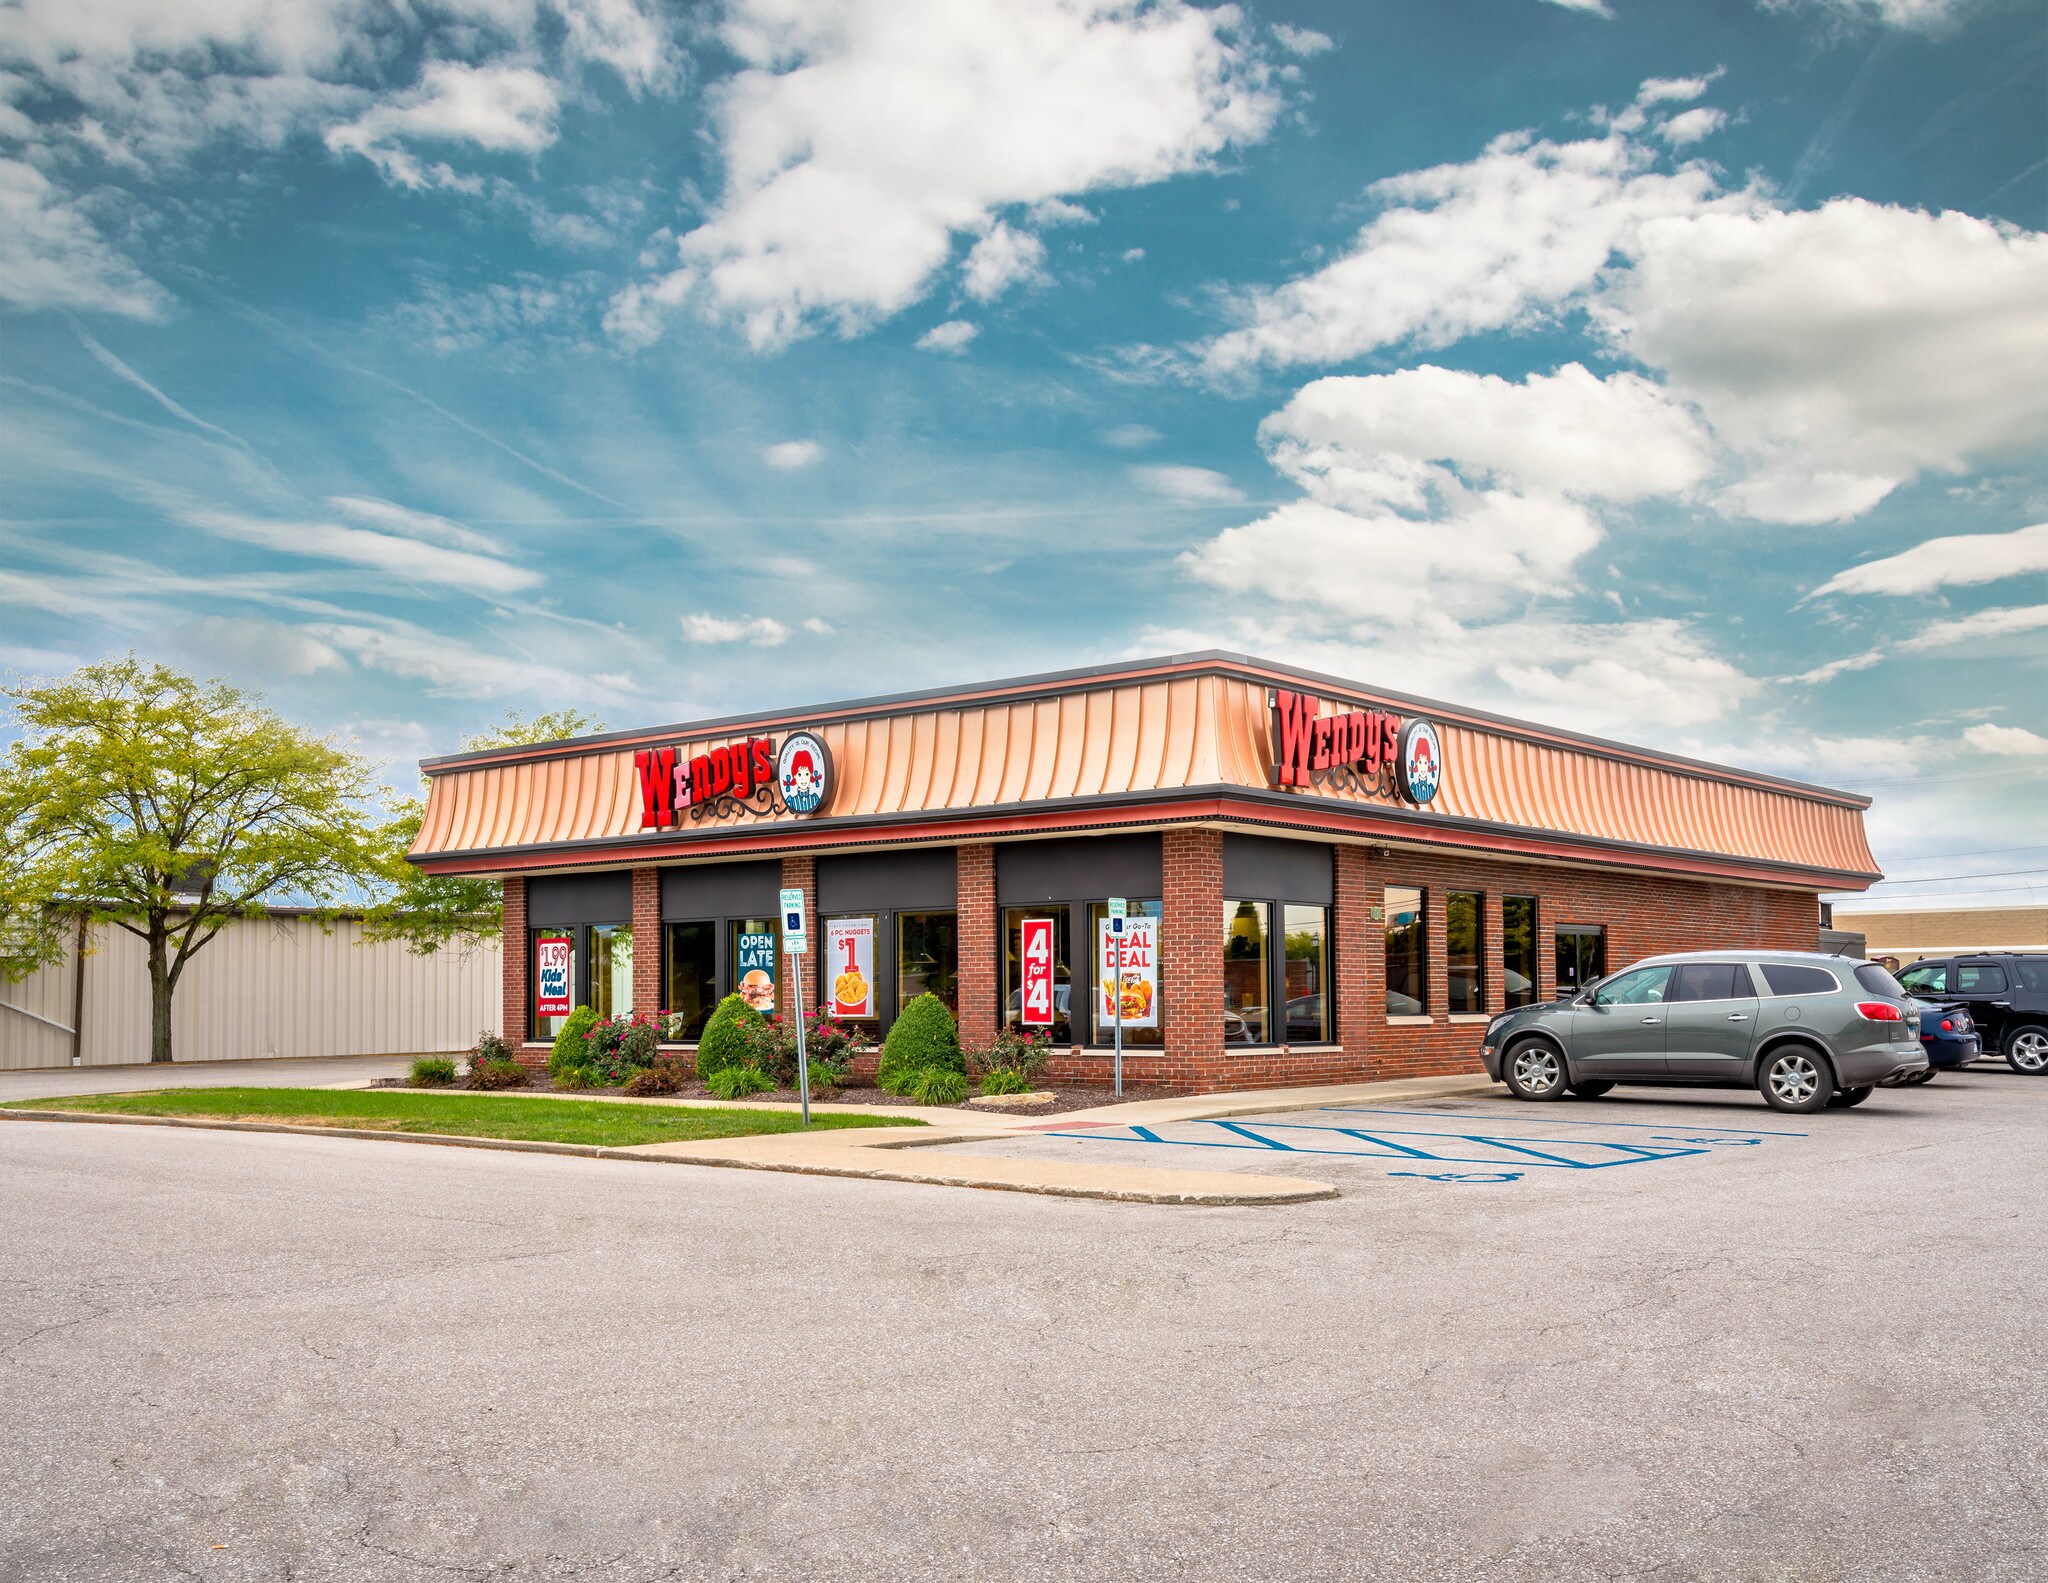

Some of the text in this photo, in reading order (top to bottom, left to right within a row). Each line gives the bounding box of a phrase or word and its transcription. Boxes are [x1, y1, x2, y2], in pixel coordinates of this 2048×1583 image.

[1276, 689, 1398, 788] Wendy's
[635, 737, 772, 828] Wendy's
[845, 928, 871, 936] NUGGETS
[1132, 922, 1152, 930] Go-To
[740, 935, 773, 949] OPEN
[1026, 928, 1048, 964] 4
[1105, 931, 1152, 949] MEAL
[541, 946, 567, 967] $1.99
[739, 950, 774, 967] LATE
[1106, 950, 1151, 968] DEAL
[541, 968, 566, 983] Kids'
[1027, 963, 1046, 978] for
[543, 981, 567, 996] Meal
[1026, 978, 1049, 1014] $4
[540, 1004, 556, 1012] AFTER
